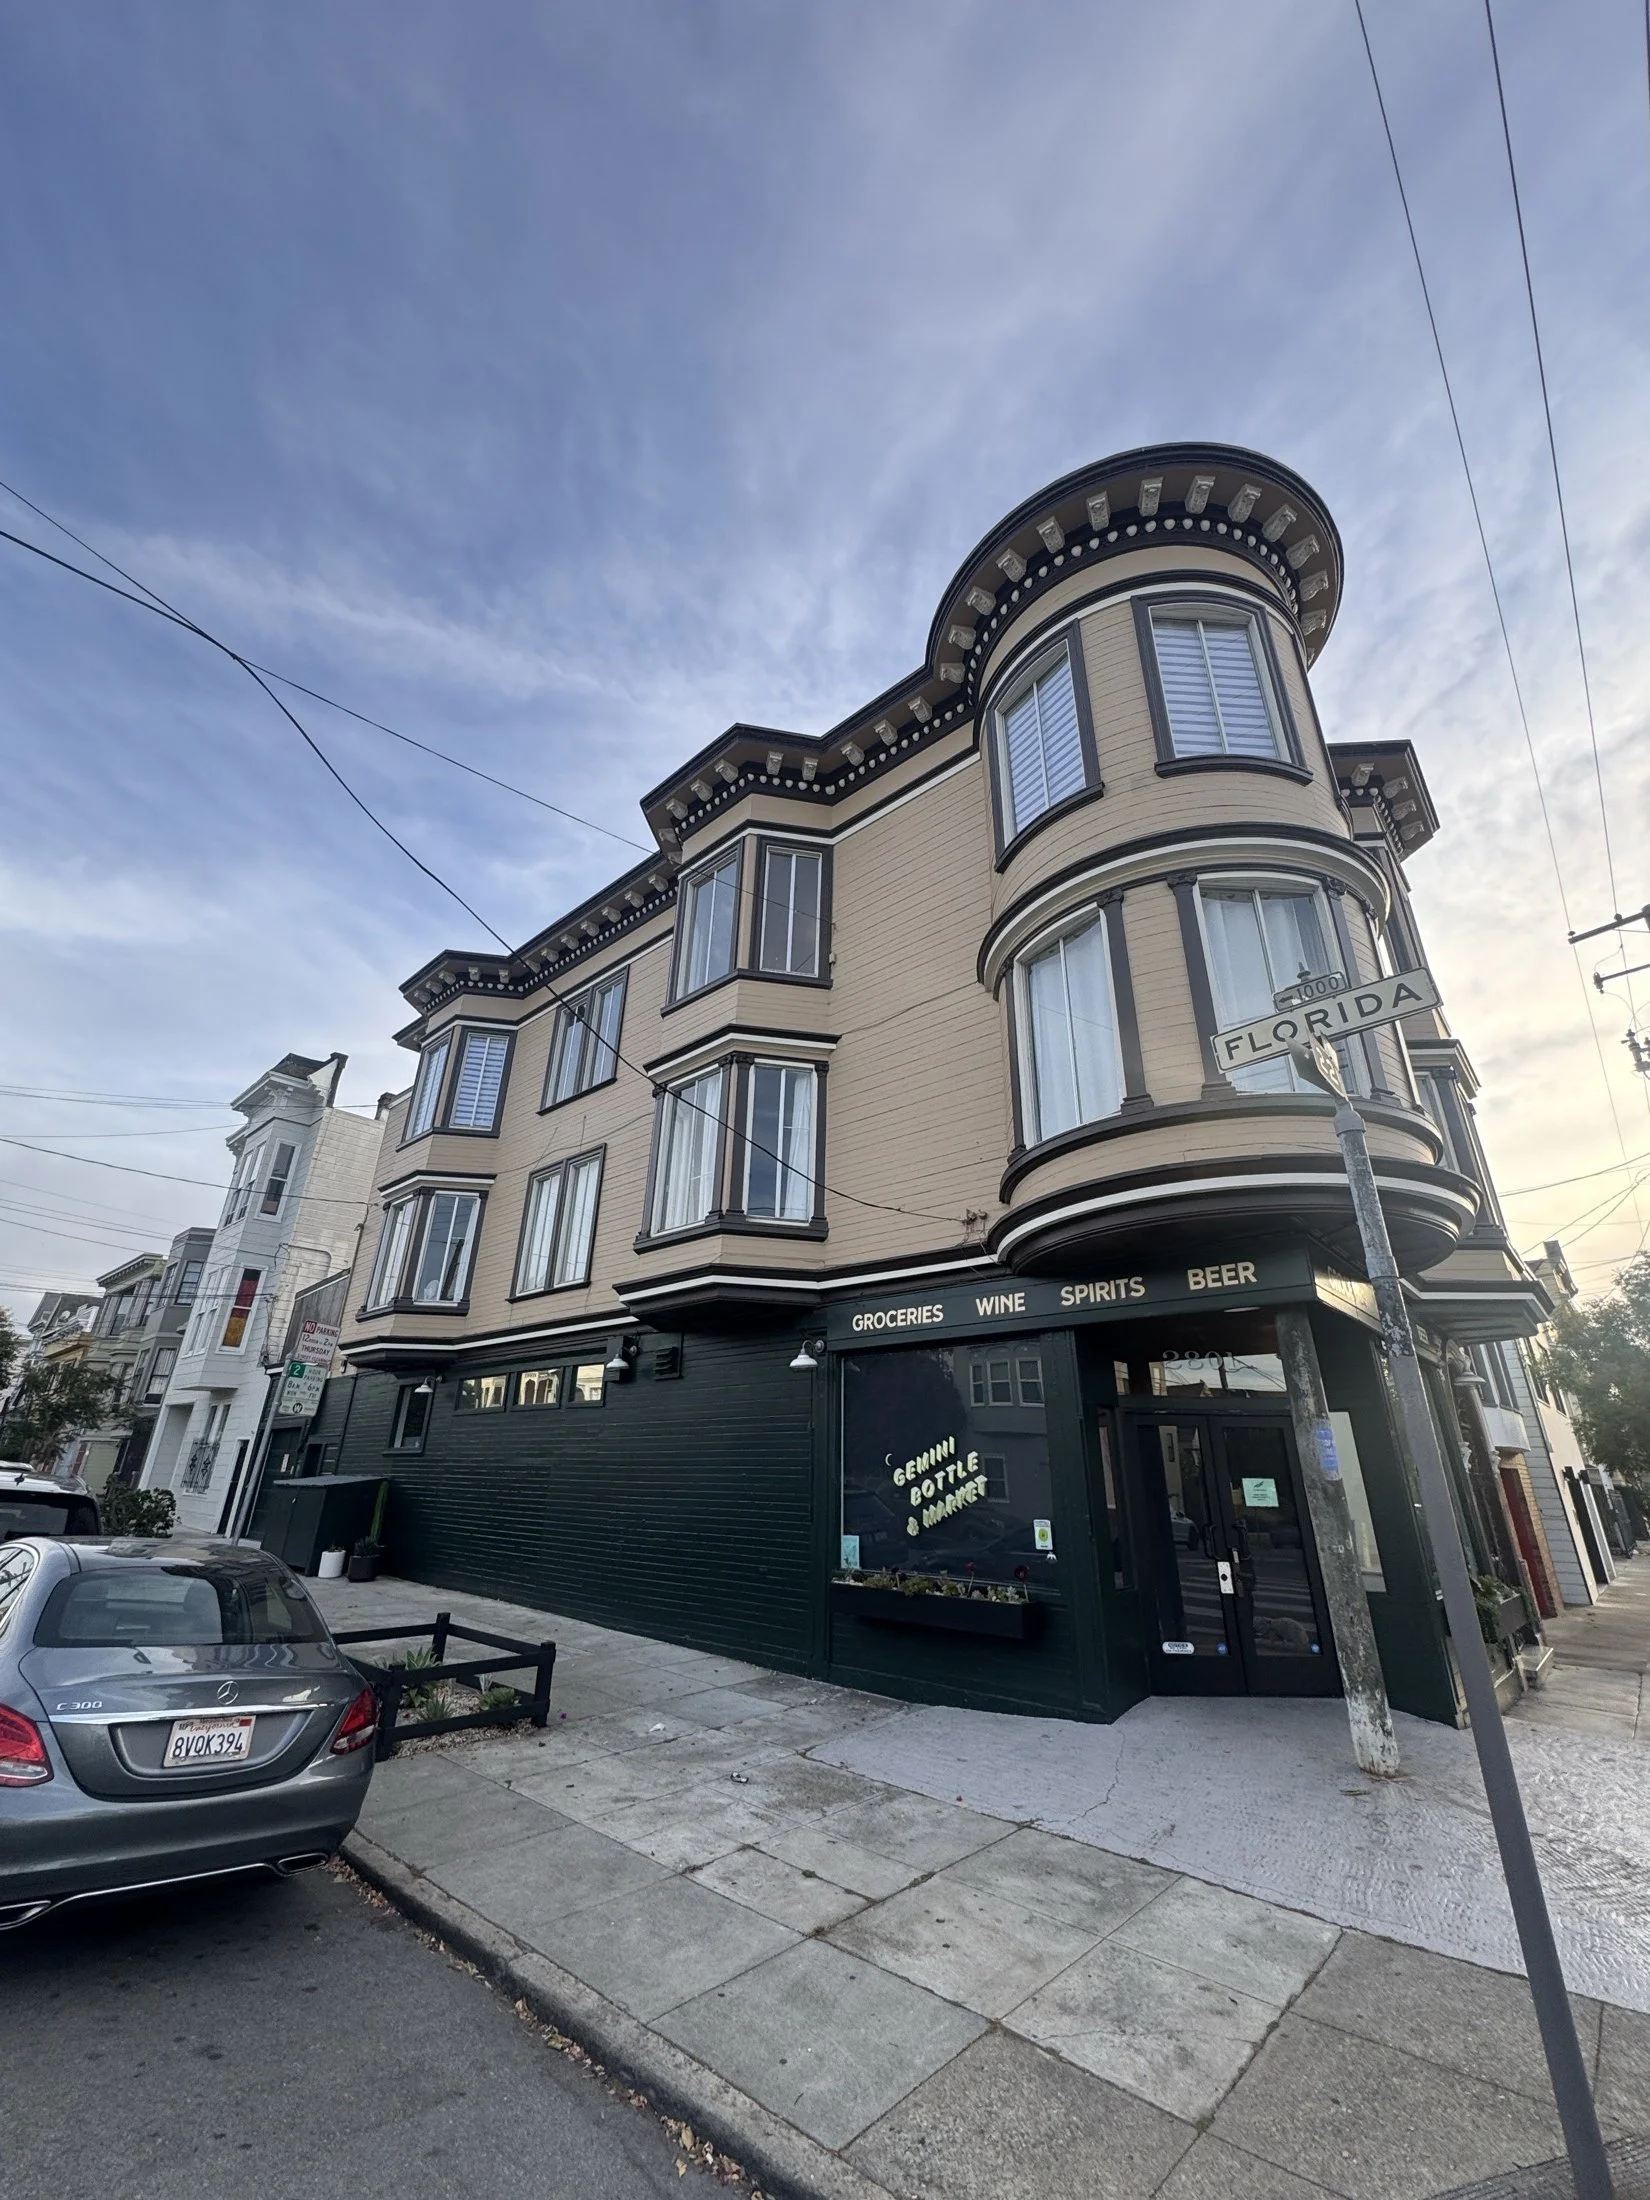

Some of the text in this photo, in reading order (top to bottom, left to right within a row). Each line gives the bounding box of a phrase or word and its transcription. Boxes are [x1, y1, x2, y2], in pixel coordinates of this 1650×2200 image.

[1297, 976, 1340, 1000] 1000
[1224, 982, 1423, 1060] FLORIDA
[852, 1261, 1257, 1331] GROCERIES WINE SPIRITS BEER
[304, 1321, 339, 1338] NO PARKING
[301, 1344, 330, 1355] THURSDAY
[1163, 1350, 1236, 1371] 2801
[293, 1364, 301, 1376] 2
[893, 1436, 955, 1487] GEMINI
[910, 1451, 979, 1507] BOTTLE
[906, 1475, 988, 1537] & MARKET
[56, 1700, 103, 1711] C 300
[173, 1732, 243, 1757] 8VQK394
